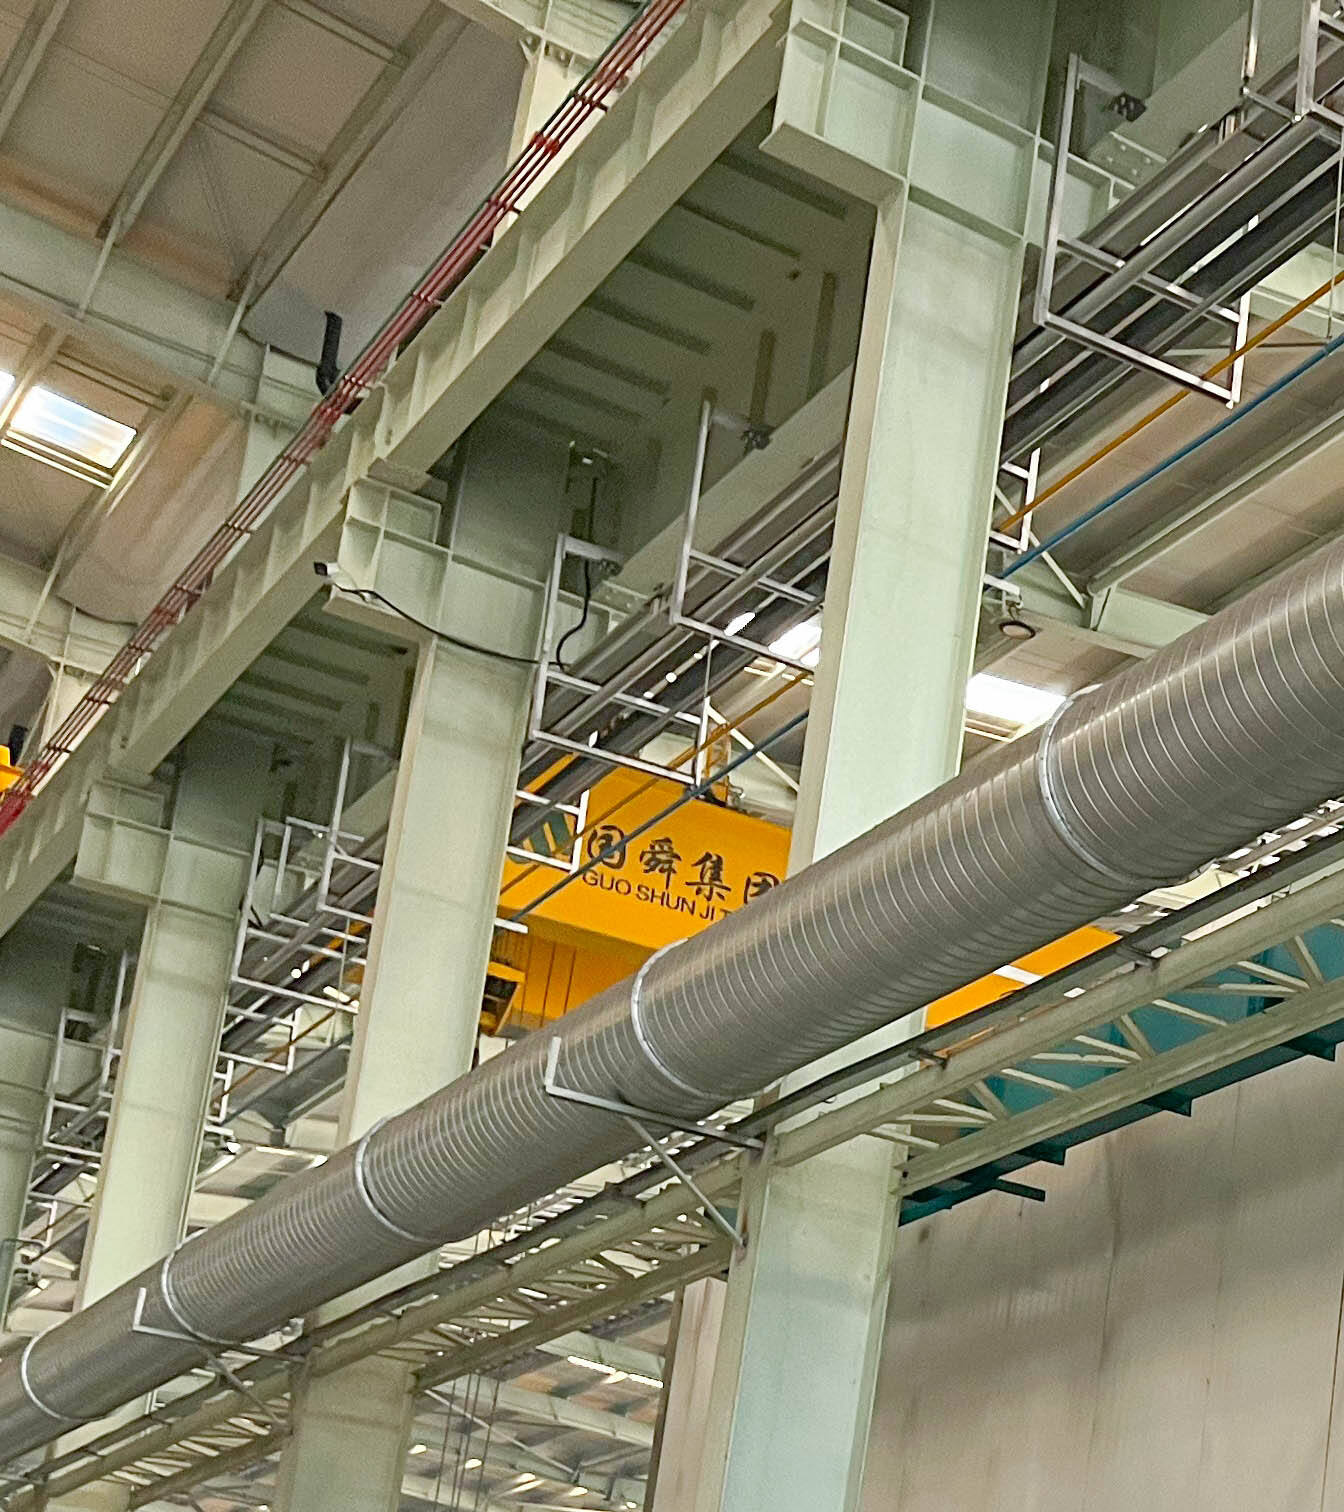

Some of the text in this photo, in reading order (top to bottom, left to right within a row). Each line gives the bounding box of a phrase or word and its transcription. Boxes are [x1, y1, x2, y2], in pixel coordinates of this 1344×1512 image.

[582, 870, 632, 896] GUO
[635, 885, 696, 916] SHUN
[699, 904, 715, 921] JI
